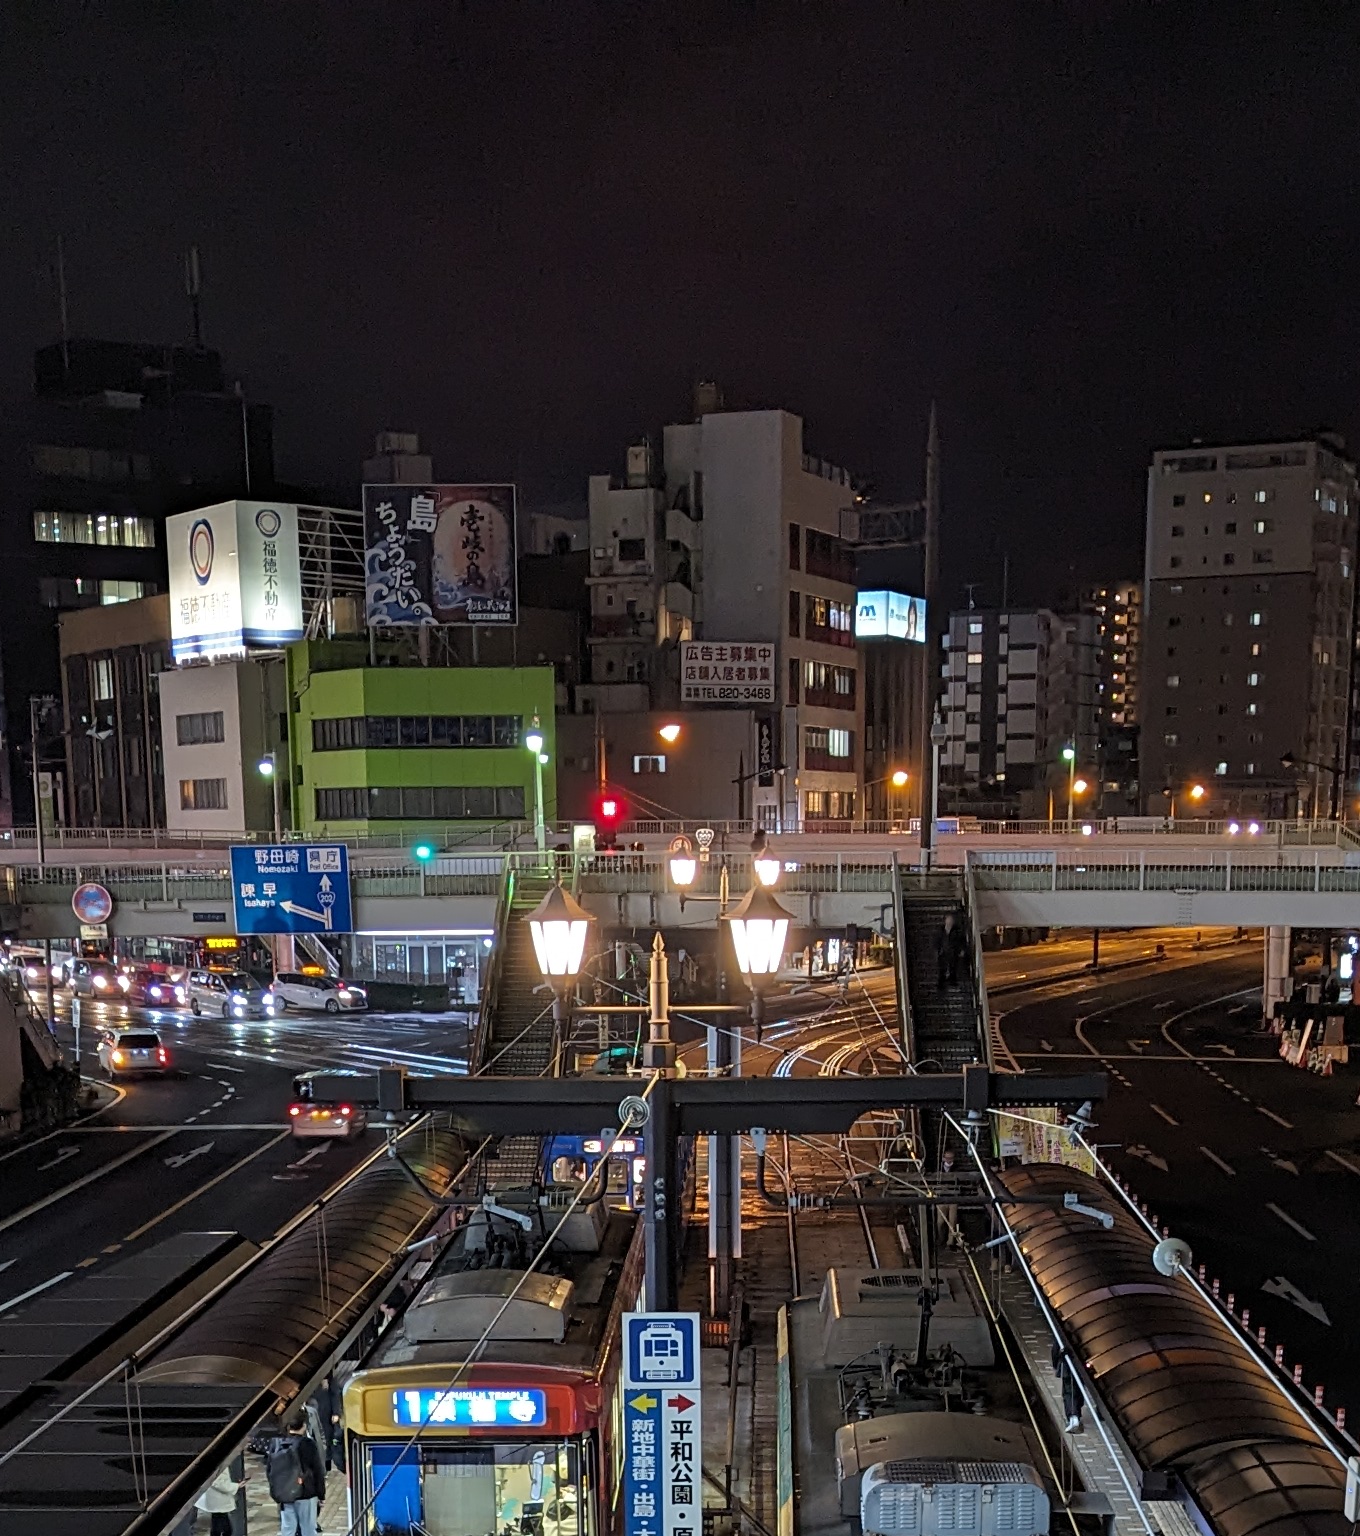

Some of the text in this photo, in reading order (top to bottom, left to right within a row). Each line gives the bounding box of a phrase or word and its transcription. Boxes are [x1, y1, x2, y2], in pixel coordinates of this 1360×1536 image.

[406, 494, 438, 533] 島
[686, 646, 770, 663] 広告主募集中
